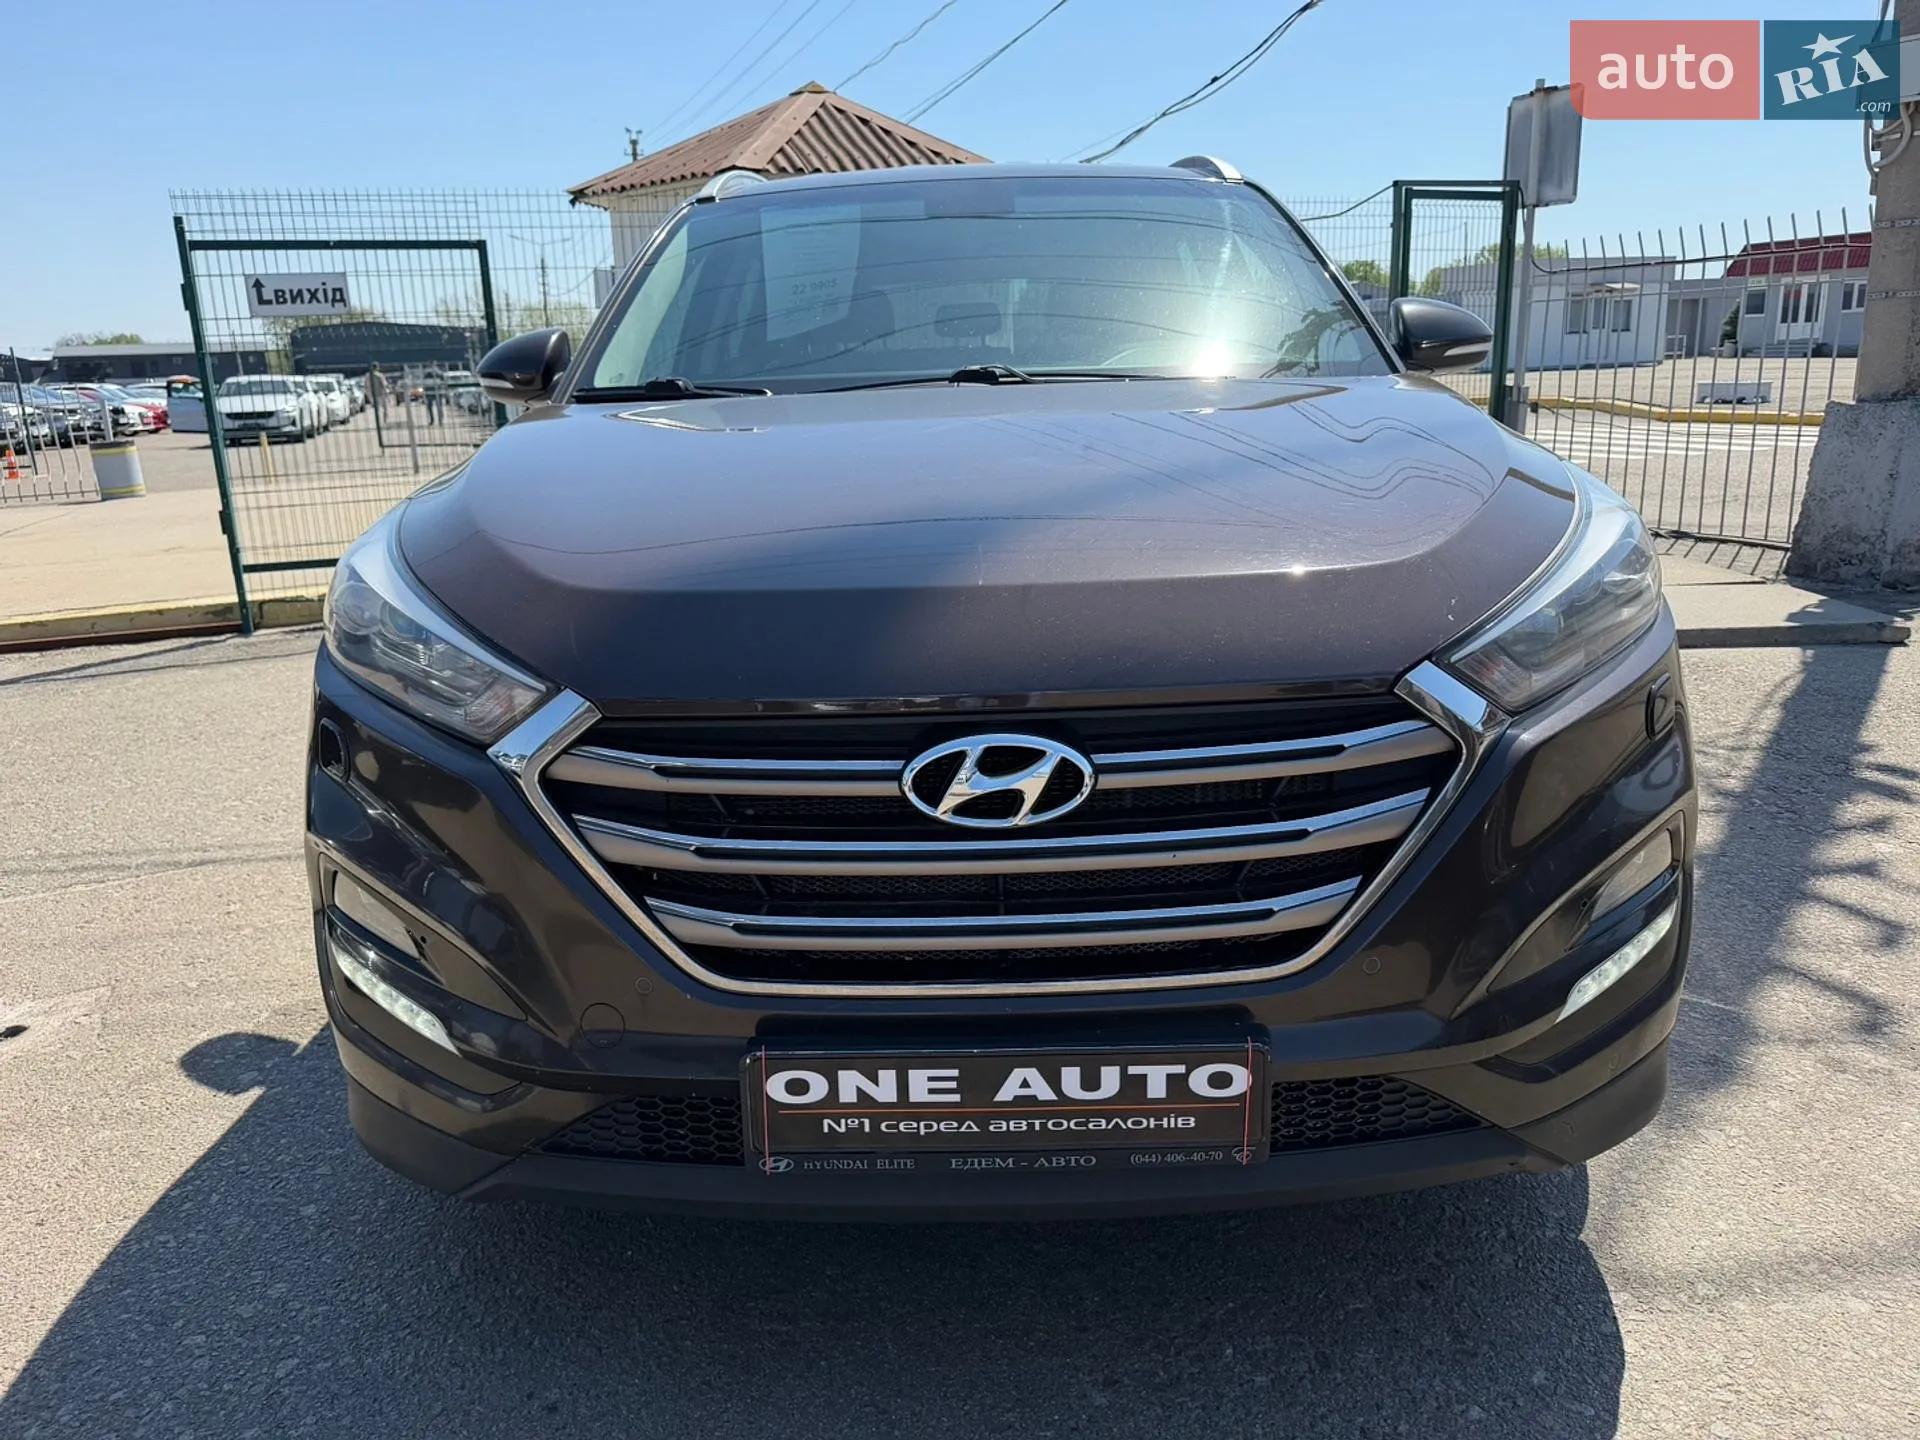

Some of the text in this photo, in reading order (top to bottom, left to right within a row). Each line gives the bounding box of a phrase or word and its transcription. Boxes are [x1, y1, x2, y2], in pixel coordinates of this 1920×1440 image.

[766, 1063, 1252, 1105] ONE AUTO
[880, 1119, 981, 1136] серед
[988, 1112, 1197, 1133] автосалонів
[803, 1158, 917, 1170] HYUNDAI ELITE
[950, 1156, 1016, 1171] ЕДЕМ
[1033, 1155, 1097, 1168] АВТО
[1130, 1152, 1161, 1166] (044)
